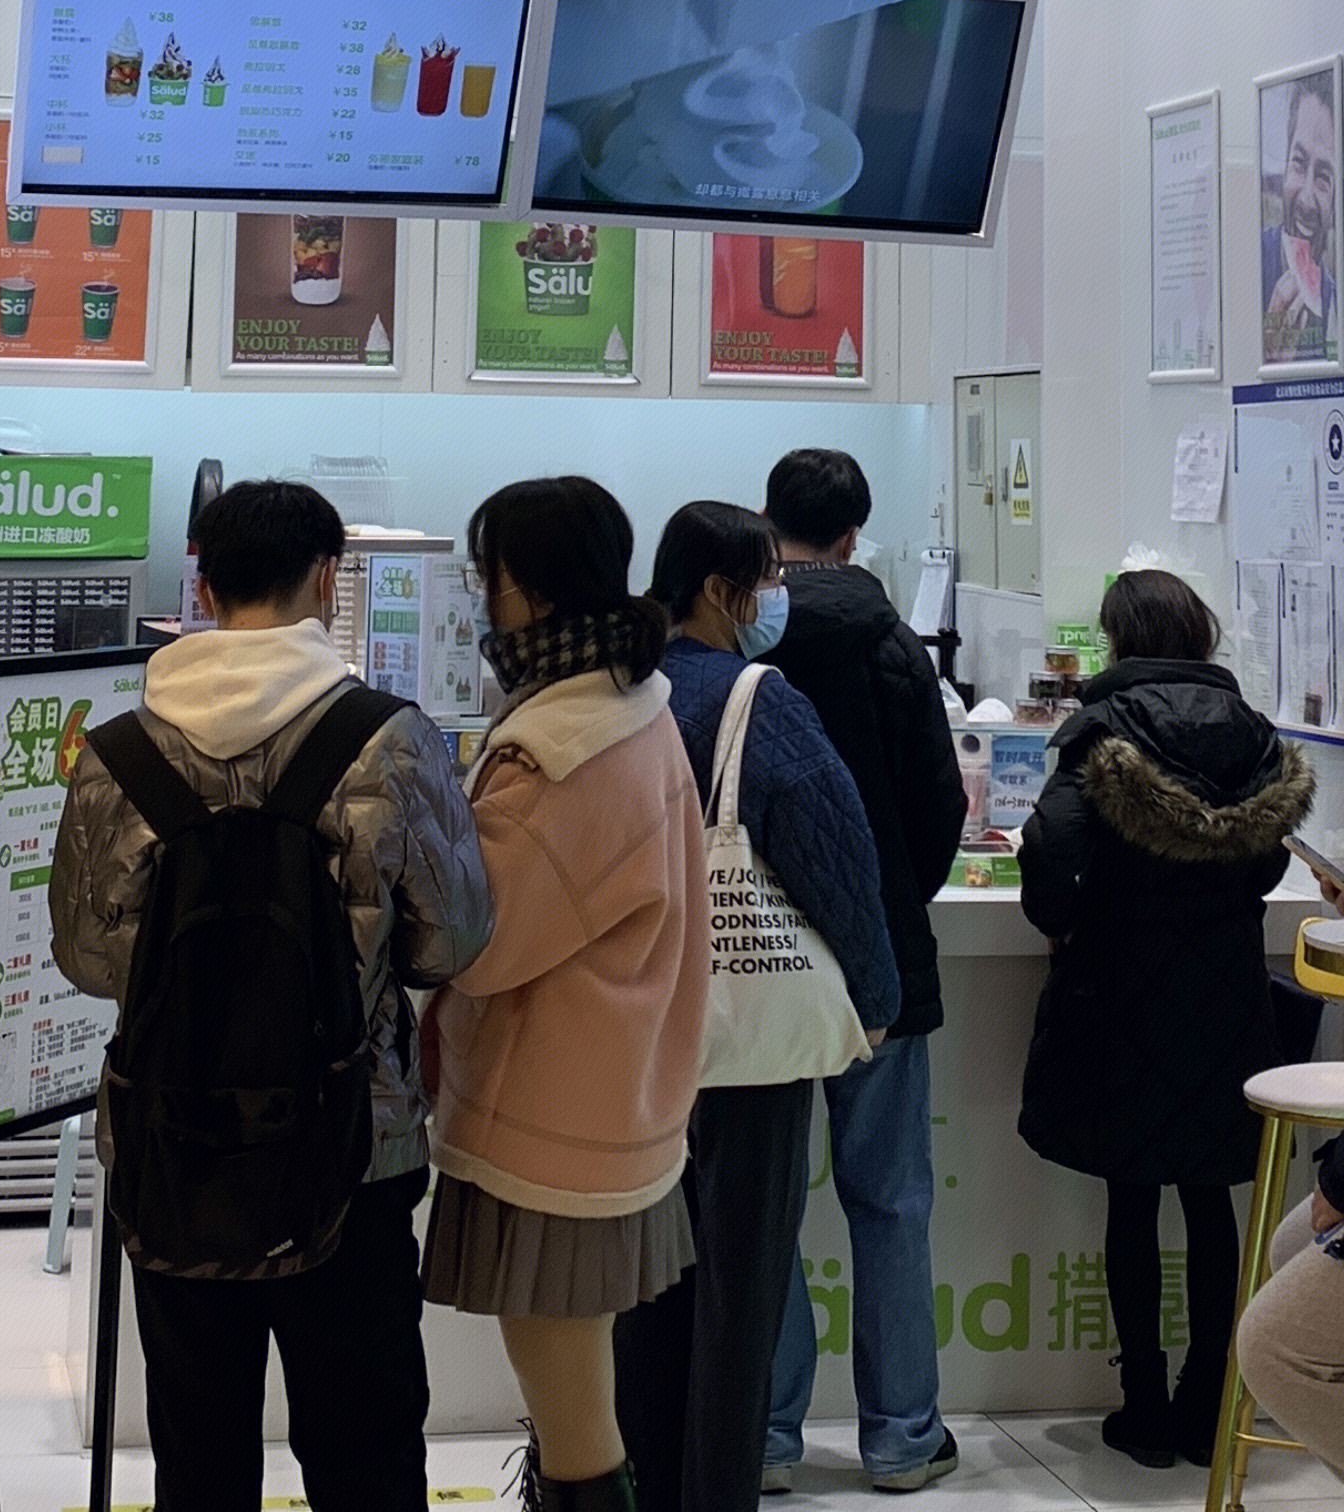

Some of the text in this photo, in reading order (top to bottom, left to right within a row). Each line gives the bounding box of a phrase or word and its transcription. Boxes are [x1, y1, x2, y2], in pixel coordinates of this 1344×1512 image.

[528, 267, 593, 296] Sälu
[237, 319, 301, 335] ENJOY
[236, 336, 359, 351] YOUR TASTE!
[714, 329, 773, 345] ENJOY
[713, 345, 828, 364] YOUR TASTE!
[10, 701, 58, 732] 会员日
[3, 738, 56, 786] 全场
[710, 955, 814, 975] F-CONTROL
